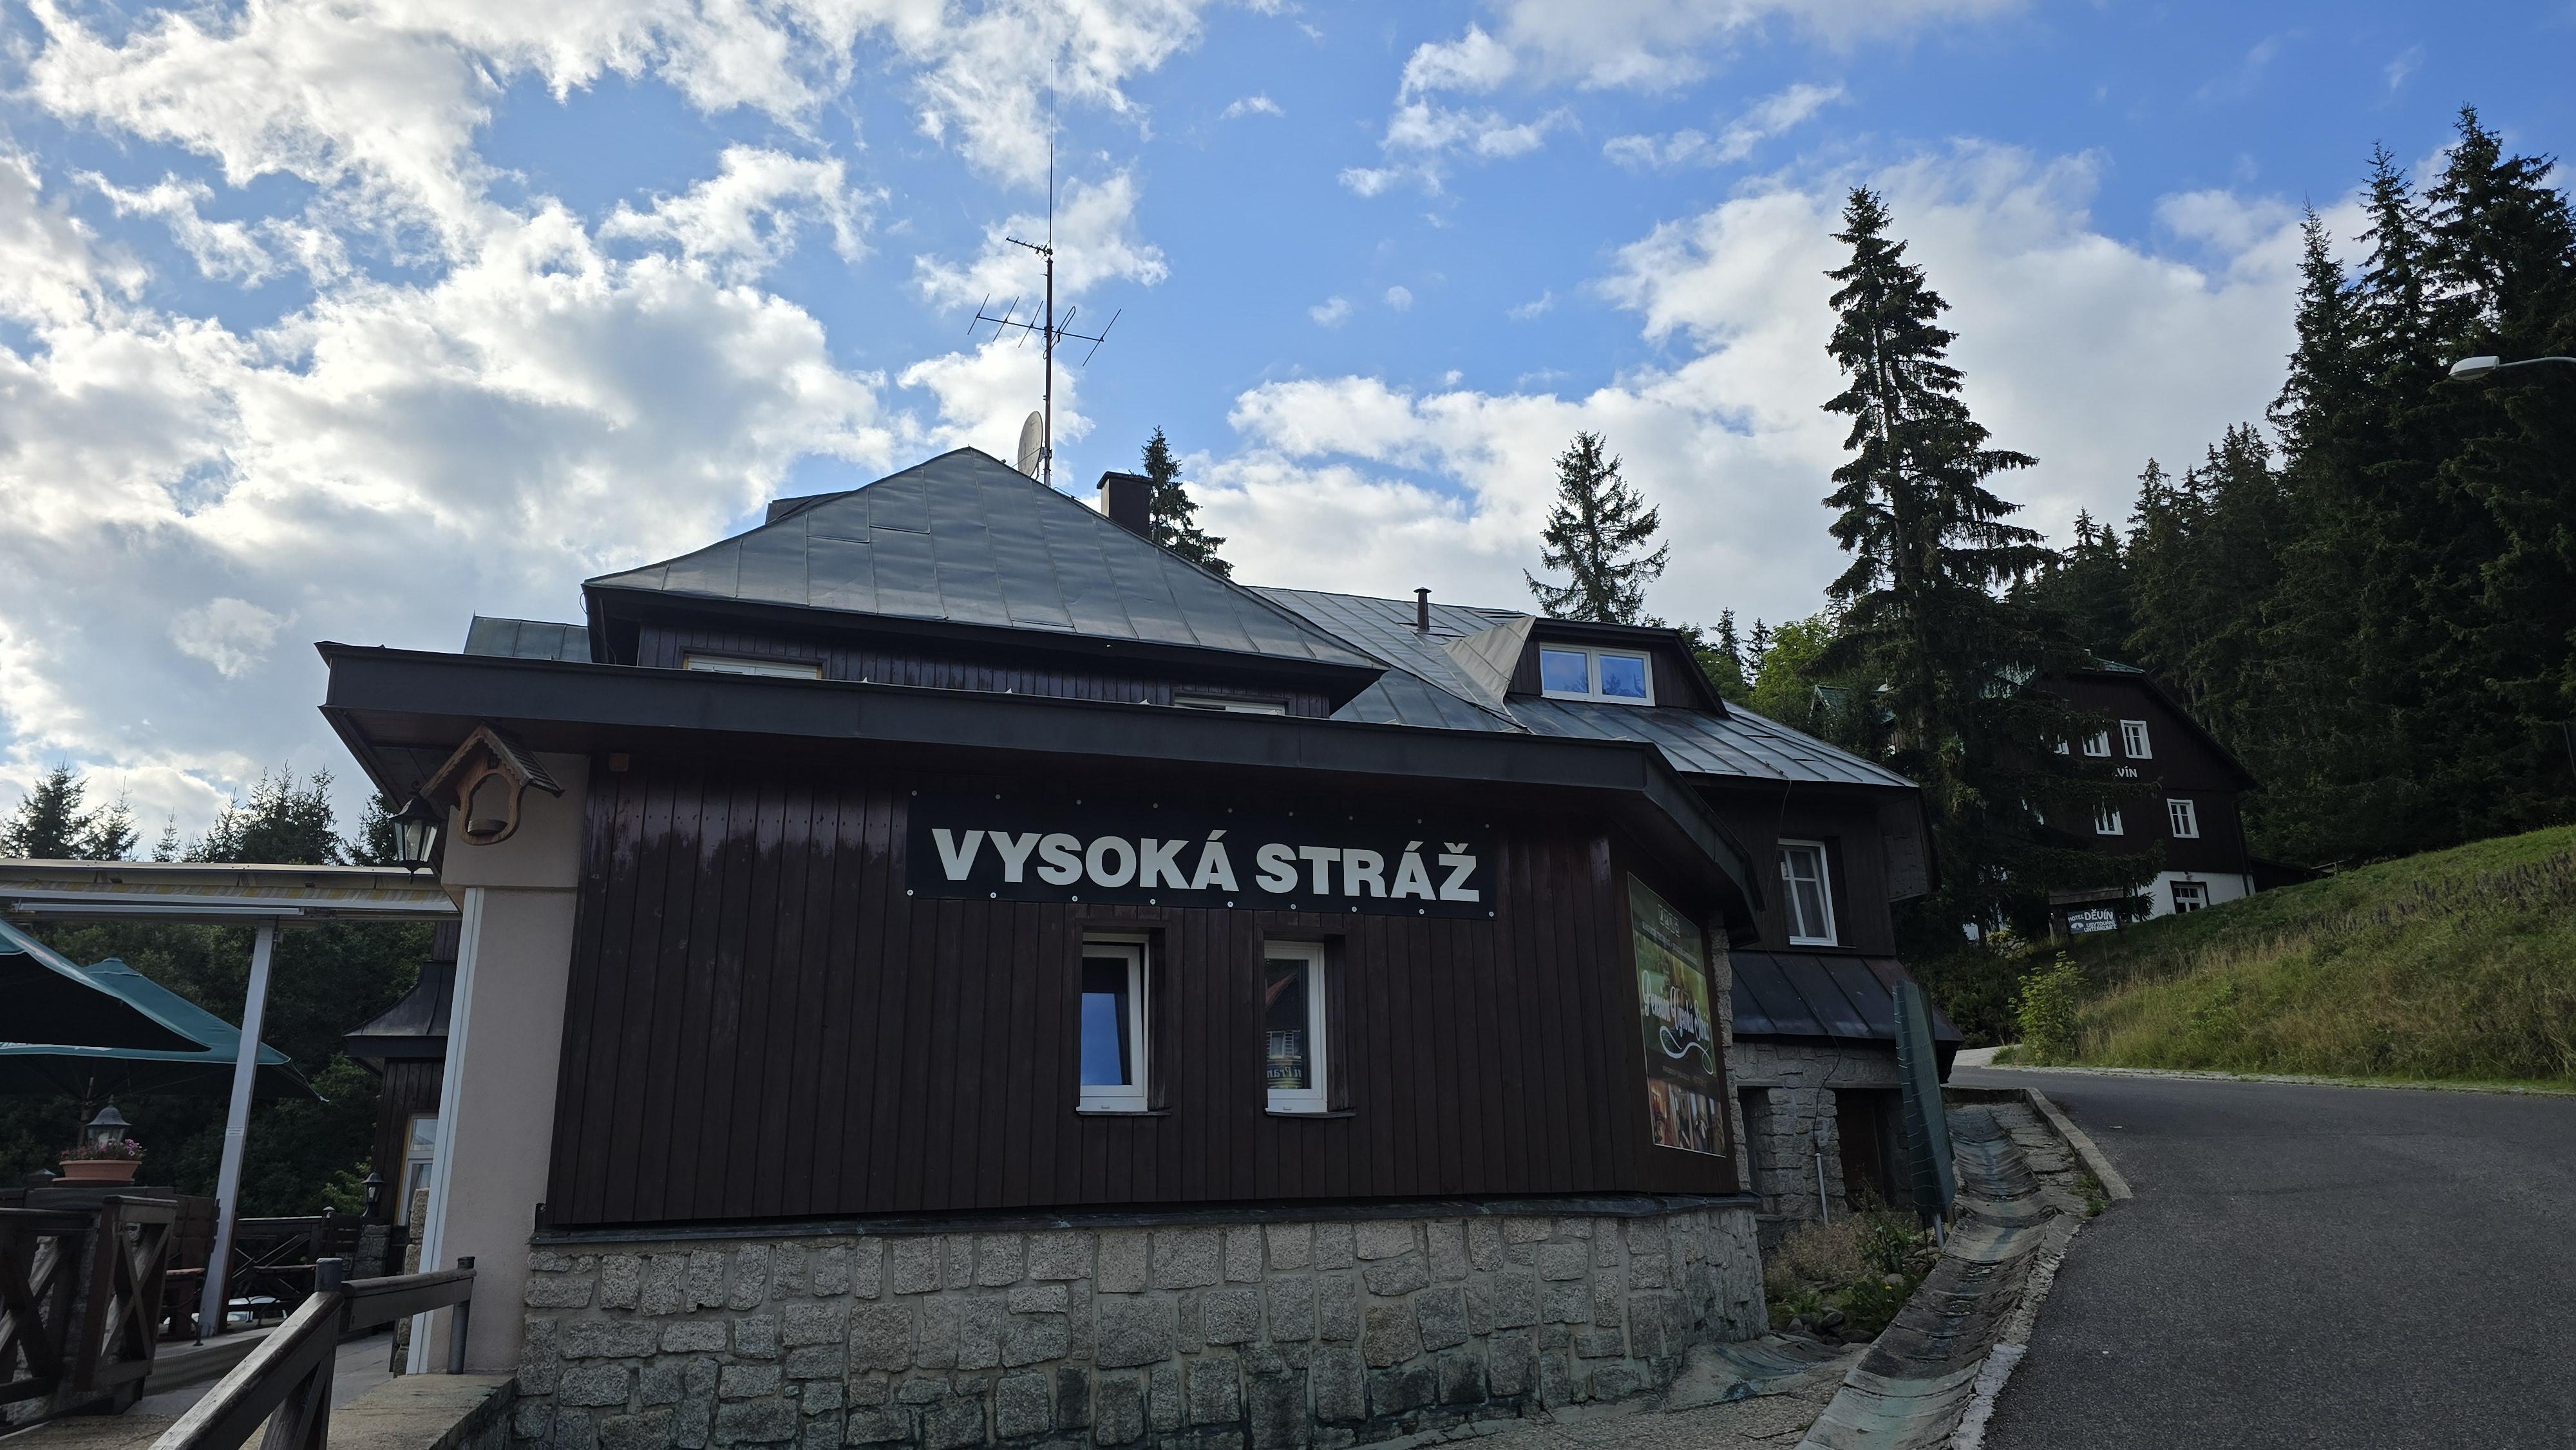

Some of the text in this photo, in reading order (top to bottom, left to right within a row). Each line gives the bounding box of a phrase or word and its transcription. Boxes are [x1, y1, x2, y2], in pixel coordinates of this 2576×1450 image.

[2115, 766, 2138, 778] VÍN
[931, 828, 1480, 902] VYSOKÁ STRÁŽ
[2084, 909, 2114, 921] DĚVÍN
[1642, 969, 1671, 1023] Pension
